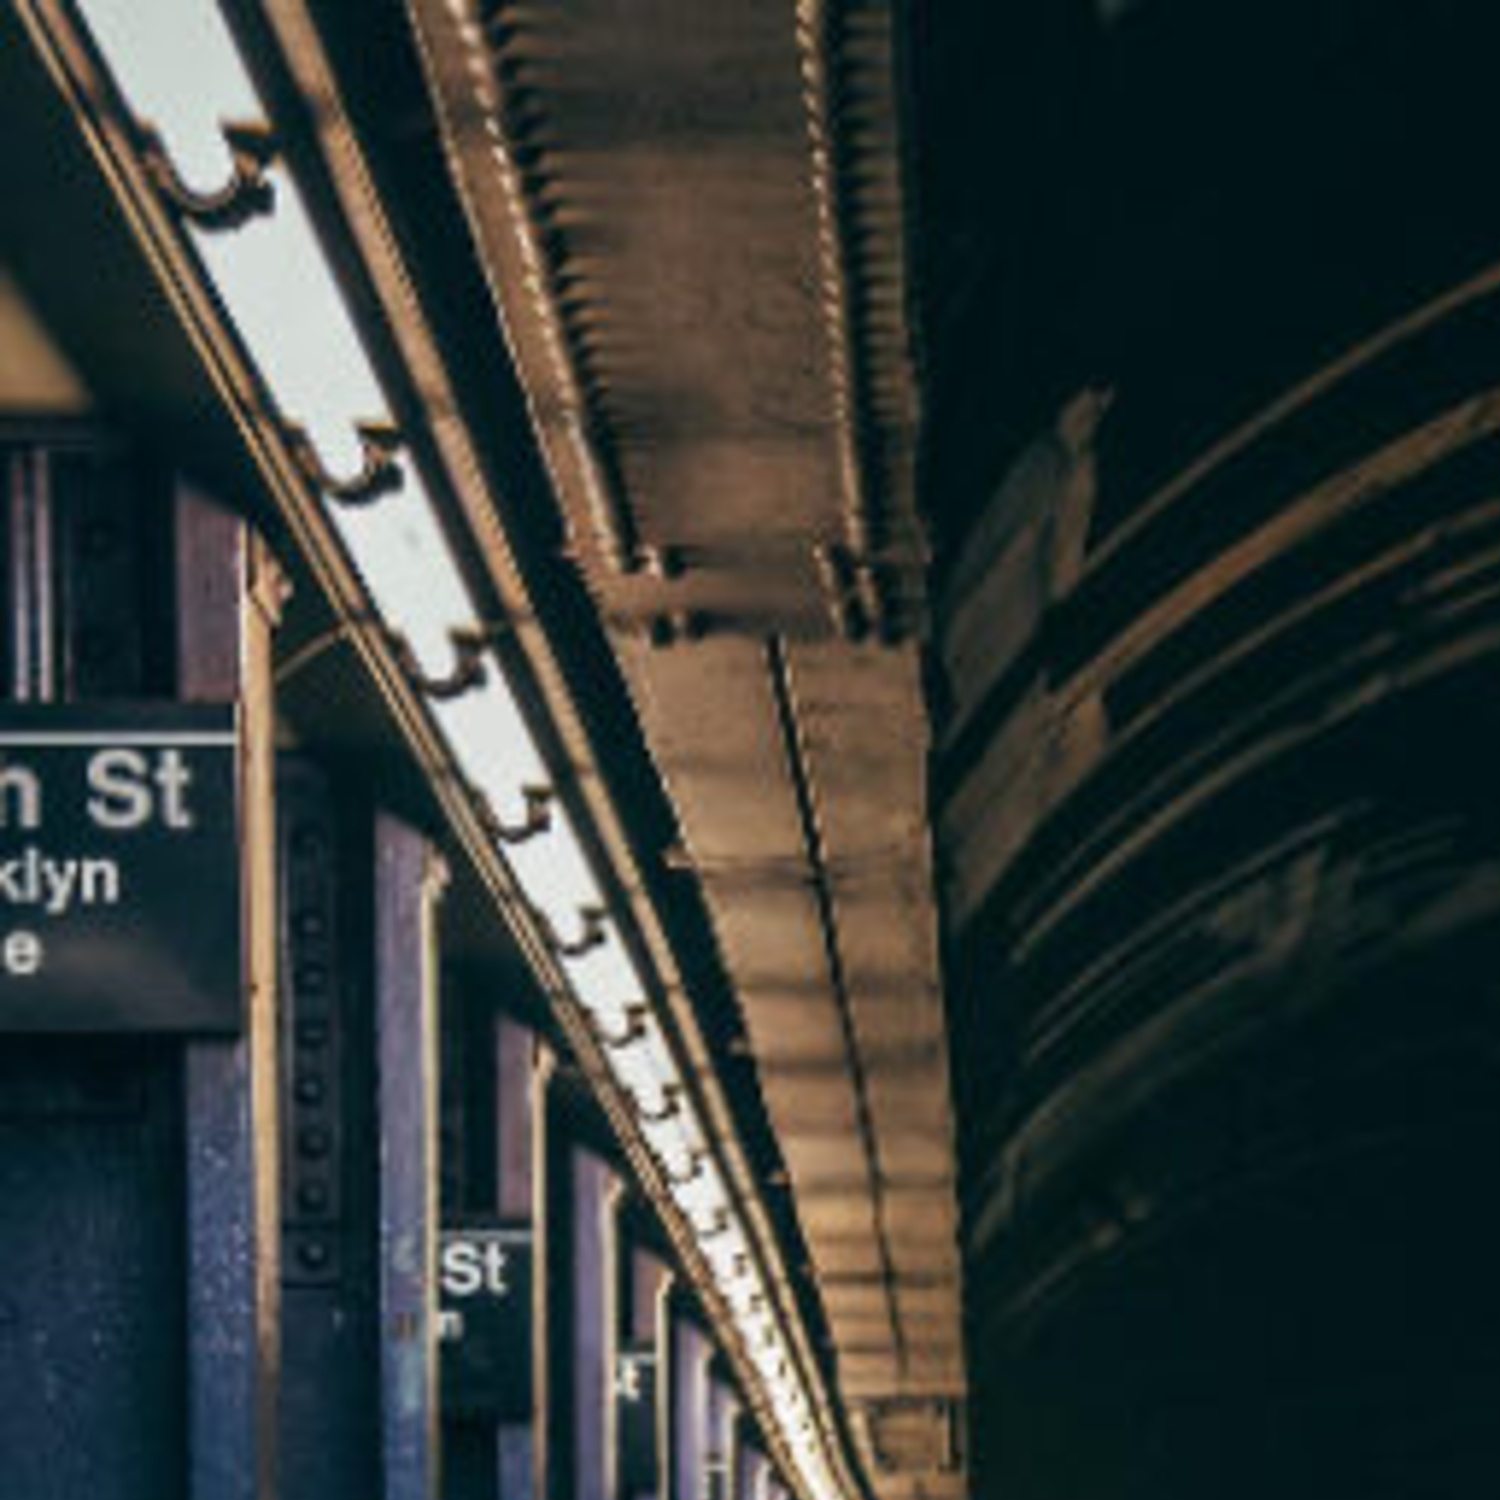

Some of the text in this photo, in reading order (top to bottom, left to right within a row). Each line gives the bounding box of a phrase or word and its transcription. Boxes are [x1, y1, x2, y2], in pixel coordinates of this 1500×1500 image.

[86, 748, 192, 829] St
[0, 847, 119, 914] klyn
[4, 931, 41, 974] e
[442, 1240, 508, 1296] St
